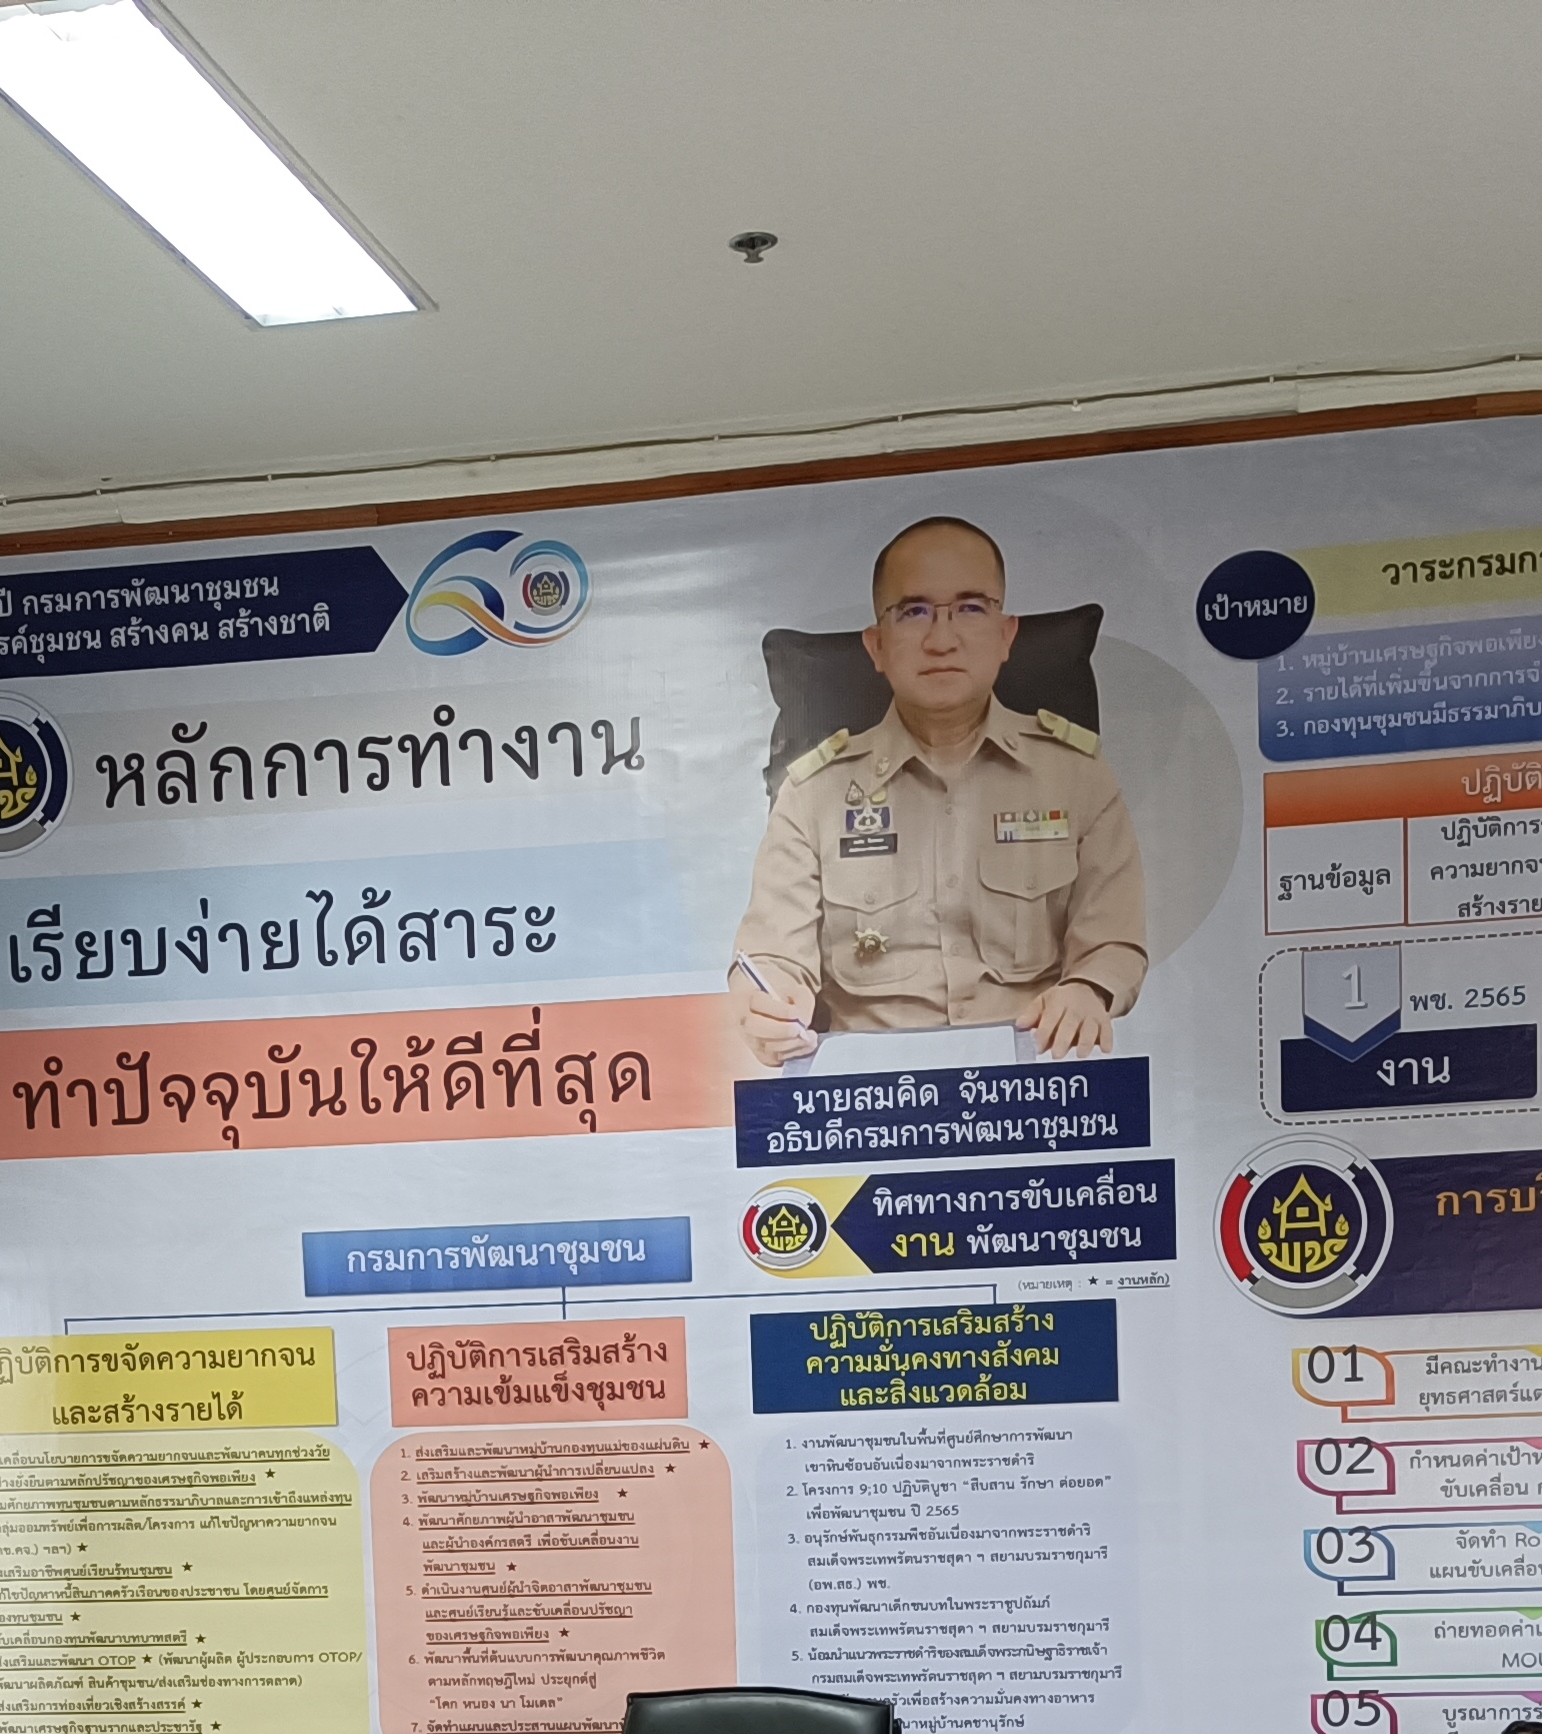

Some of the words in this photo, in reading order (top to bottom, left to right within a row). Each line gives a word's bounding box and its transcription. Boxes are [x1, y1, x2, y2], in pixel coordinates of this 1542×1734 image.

[21, 572, 280, 618] กรมการพัฒนาชุมชน
[1203, 594, 1308, 621] เป้าหมาย
[109, 615, 209, 648] สร้างคน
[217, 603, 330, 642] สร้างชาติ
[95, 703, 645, 811] หลักการทำงาน
[1278, 863, 1391, 900] ฐานข้อมูล
[9, 886, 558, 985] เรียบง่ายได้สาระ
[1464, 985, 1526, 1008] 2565
[12, 1007, 653, 1151] ทำปัจจุบันให้ดีที่สุด
[1377, 1054, 1450, 1087] งาน
[792, 1073, 940, 1117] นายสมคิด
[958, 1070, 1089, 1108] จันทมฤก
[767, 1109, 1118, 1155] อธิบดีกรมการพัฒนาชุมชน
[872, 1169, 1157, 1218] ทิศทางการขับเคลื่อน
[347, 1234, 646, 1278] กรมการพัฒนาชุมชน
[890, 1228, 955, 1260] งาน
[966, 1223, 1141, 1263] พัฒนาชุมชน
[810, 1304, 1055, 1349] ปฏิบัติการเสริมสร้าง
[407, 1336, 668, 1383] ปฏิบัติการเสริมสร้าง
[806, 1338, 1060, 1374] ความมั่นคงทางสังคม
[1308, 1344, 1364, 1384] 01
[411, 1370, 666, 1411] ความเข้มแข็งชุมชน
[840, 1372, 1027, 1406] และสิ่งแวดล้อม
[53, 1391, 244, 1426] และสร้างรายได้
[1314, 1437, 1375, 1475] 02
[802, 1481, 854, 1497] โครงการ
[1440, 1473, 1529, 1499] ขับเคลื่อน
[806, 1502, 906, 1522] เพื่อพัฒนาชุมชน
[927, 1505, 959, 1516] 2565
[1316, 1526, 1376, 1564] 03
[1455, 1528, 1506, 1549] จัดทำ
[1323, 1614, 1382, 1652] 04
[1323, 1690, 1382, 1726] 05
